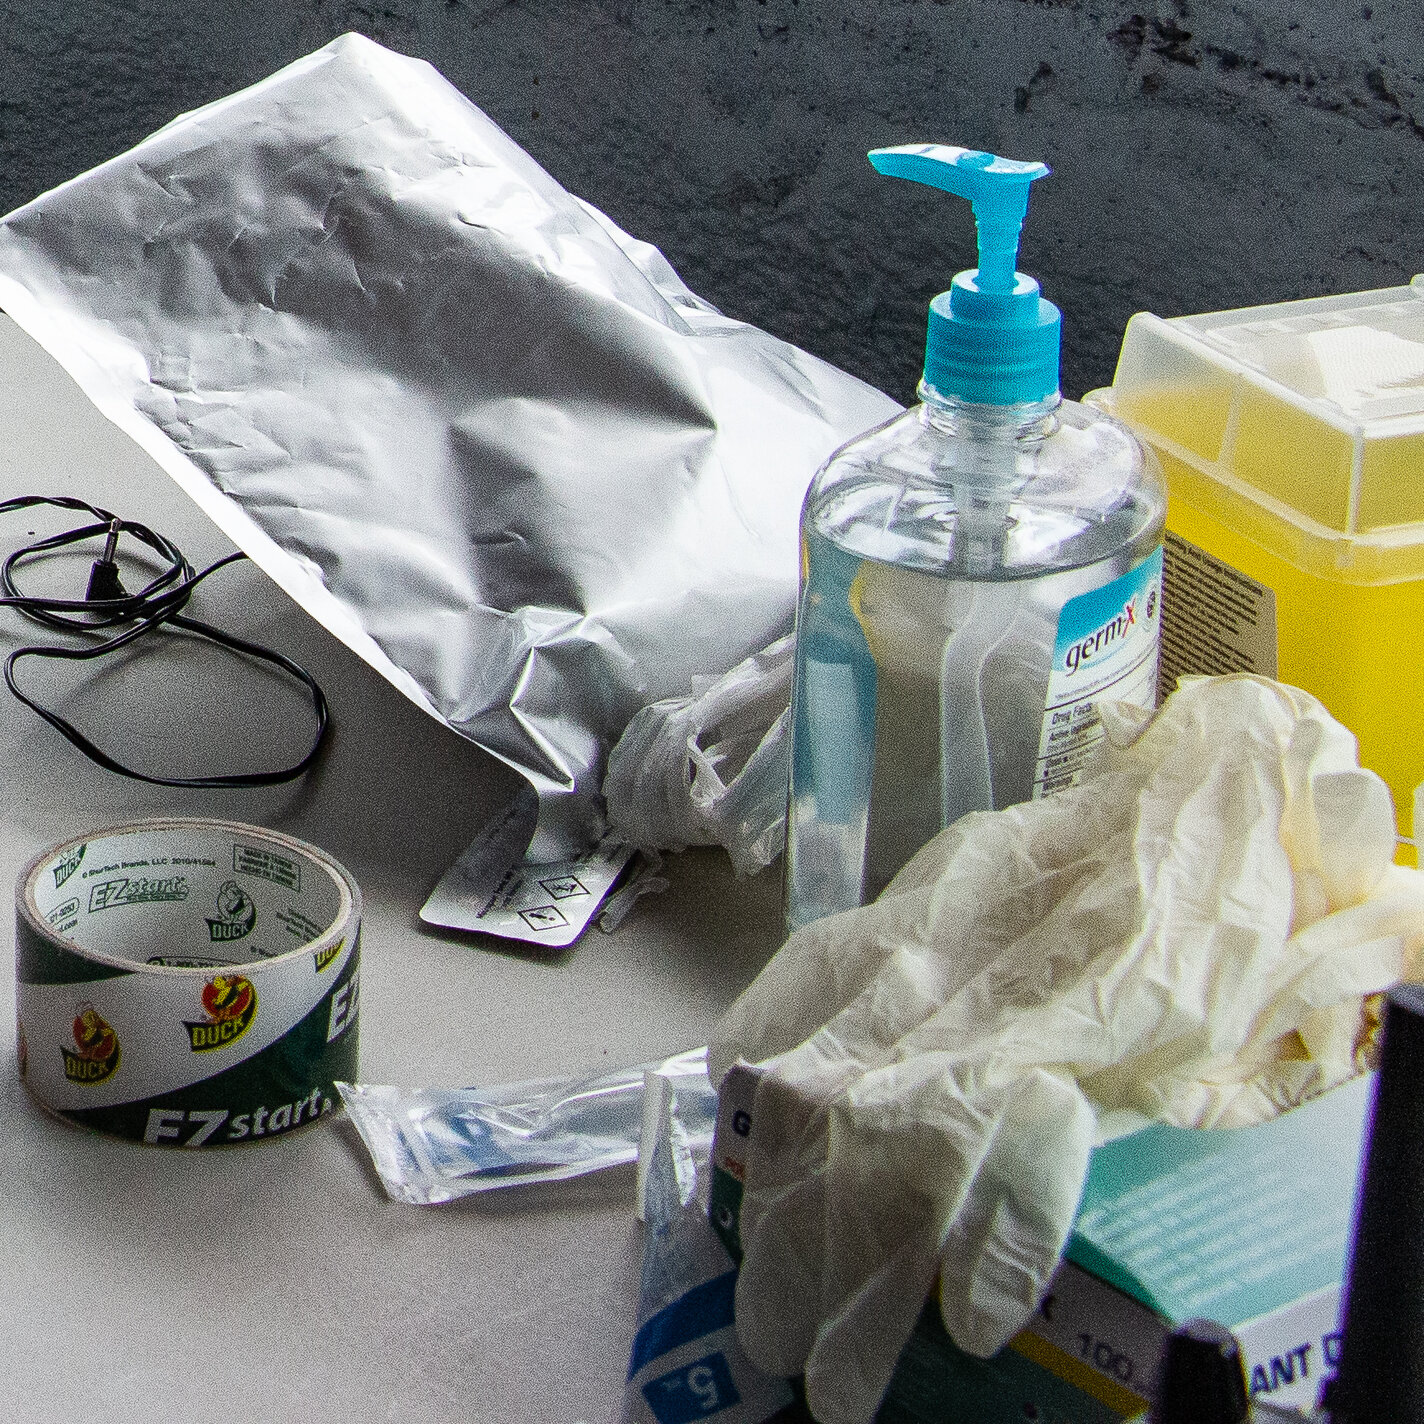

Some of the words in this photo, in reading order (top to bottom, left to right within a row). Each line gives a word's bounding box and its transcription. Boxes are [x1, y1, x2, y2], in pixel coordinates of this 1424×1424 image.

[212, 922, 249, 939] DUCK
[191, 1017, 245, 1048] DUCK
[65, 1055, 110, 1080] DUCK
